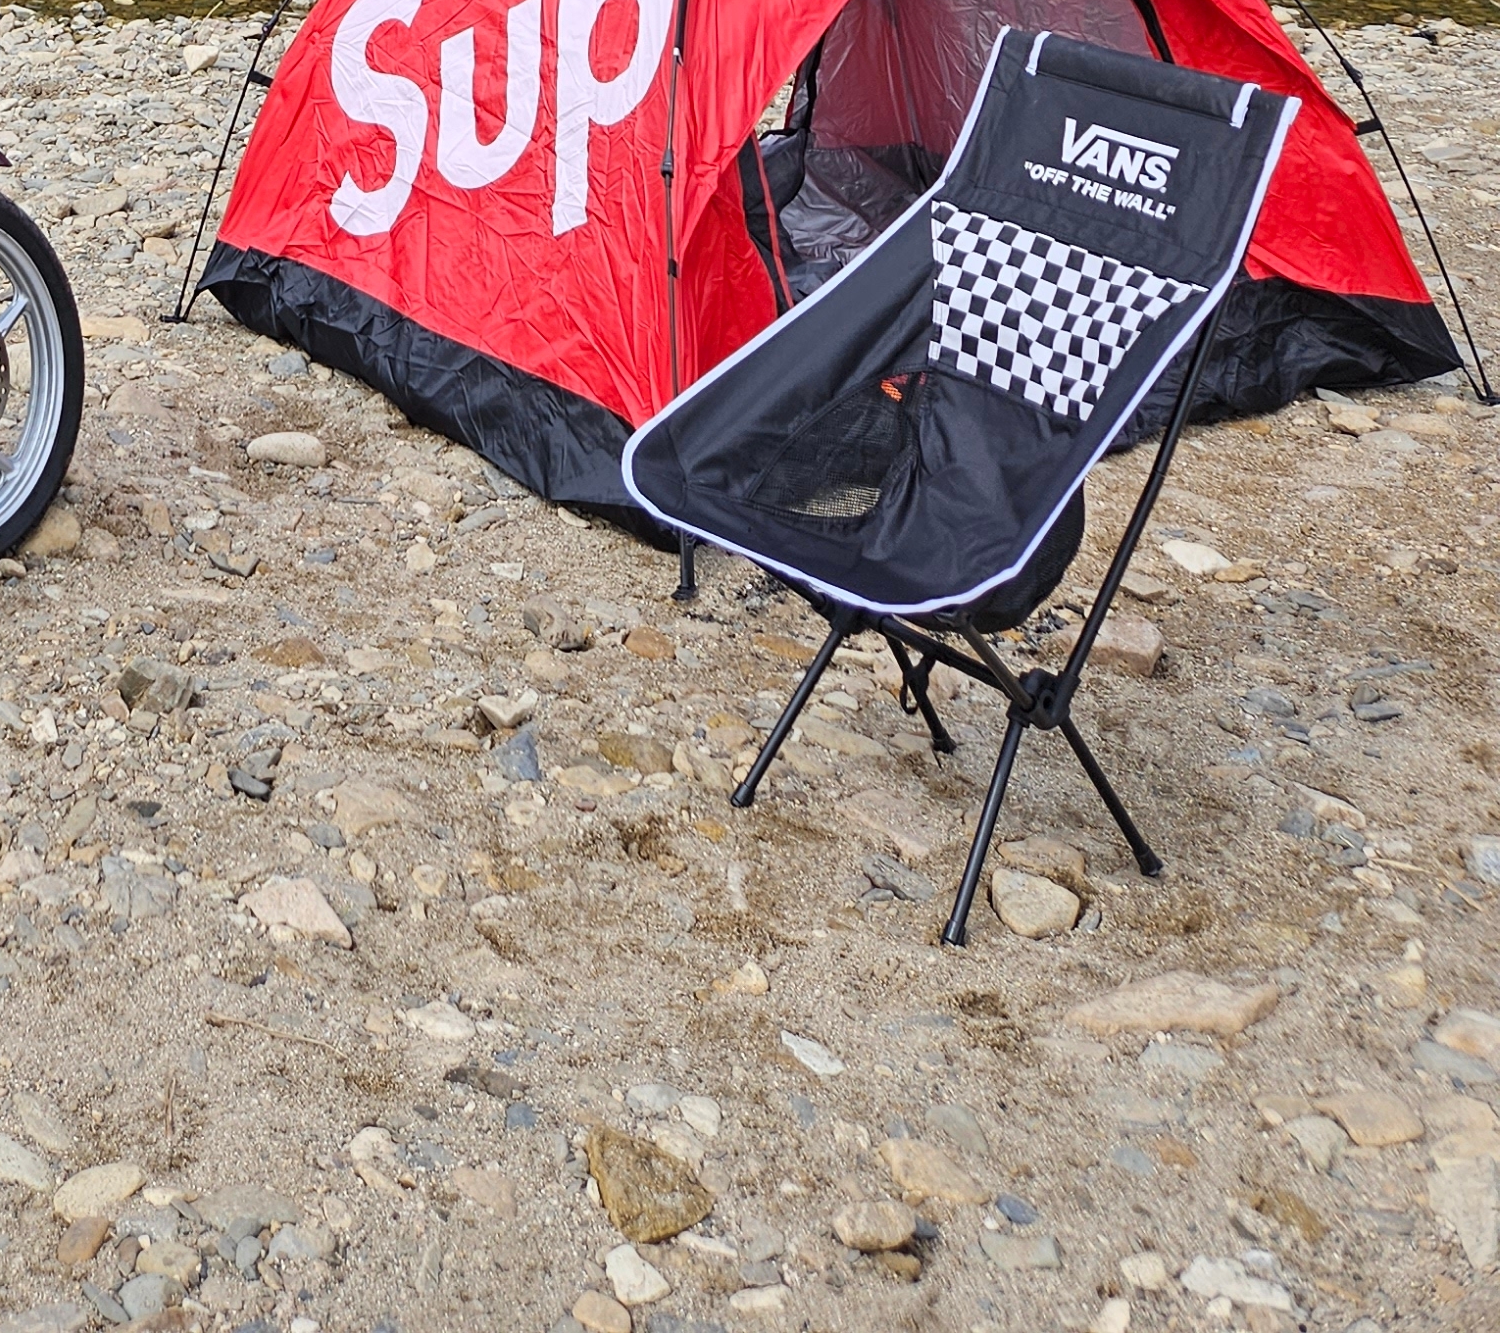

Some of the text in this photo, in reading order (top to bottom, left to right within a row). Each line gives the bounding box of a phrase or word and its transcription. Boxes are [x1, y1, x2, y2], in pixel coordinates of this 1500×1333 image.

[1061, 117, 1180, 190] VANS
[1024, 161, 1177, 221] "OFF THE WALL"
